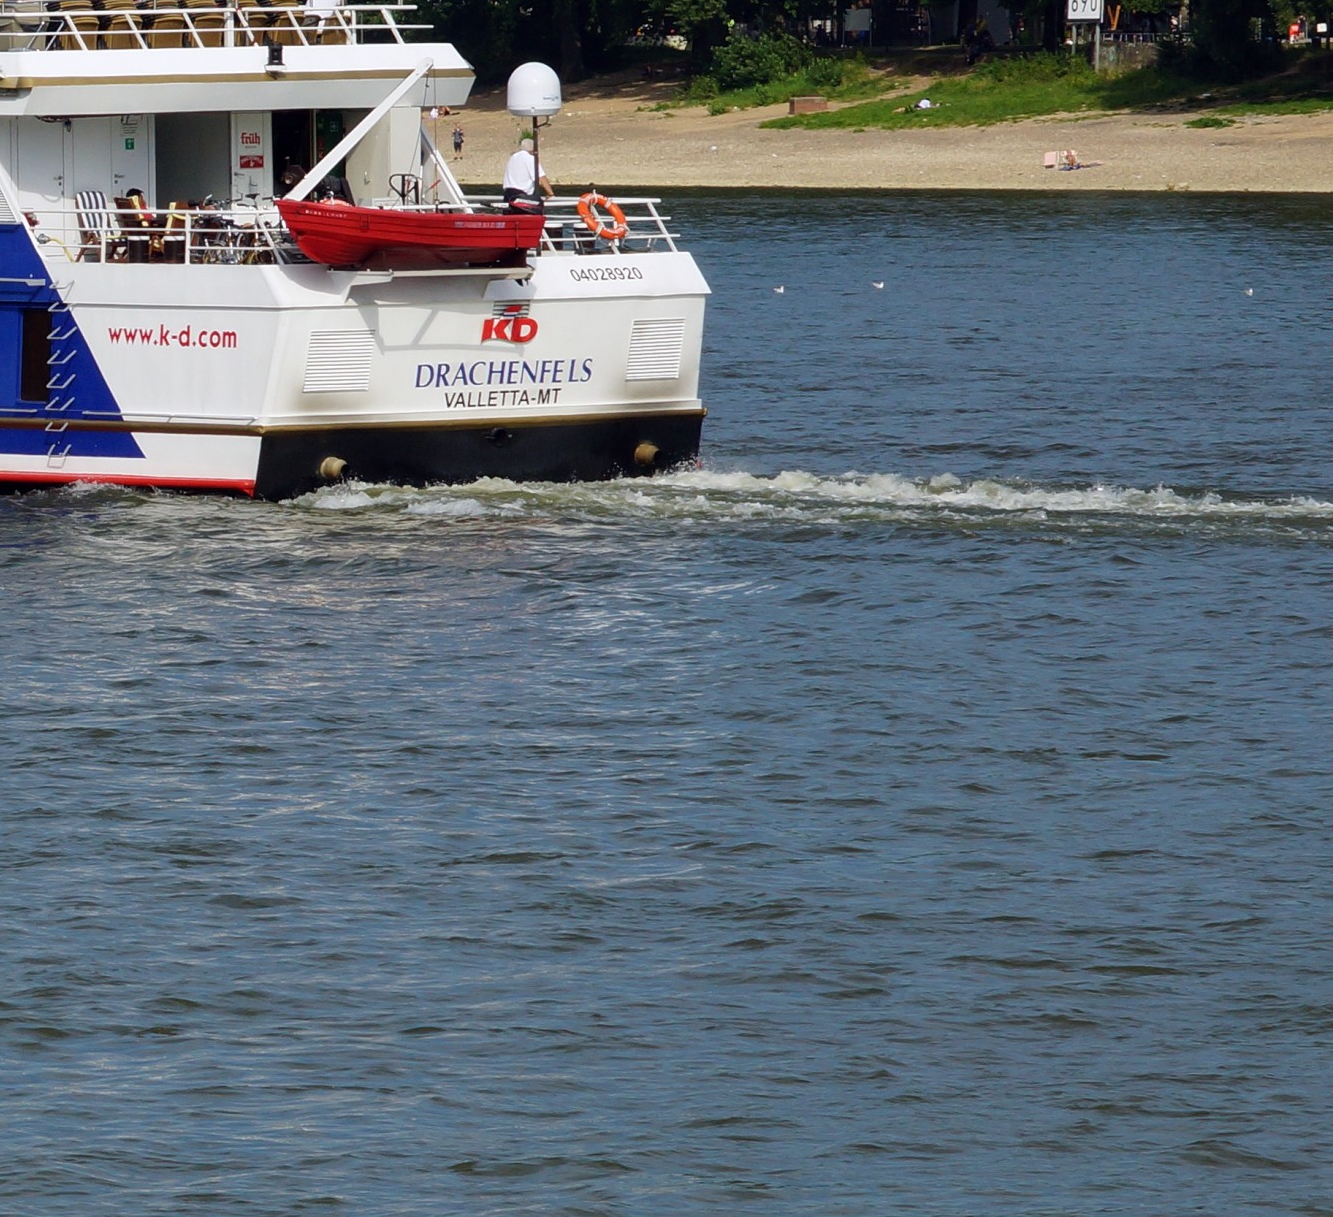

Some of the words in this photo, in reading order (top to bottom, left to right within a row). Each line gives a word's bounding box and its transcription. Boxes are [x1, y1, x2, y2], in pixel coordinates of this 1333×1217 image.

[240, 132, 261, 146] früh
[570, 266, 643, 282] 04028920
[108, 323, 237, 349] www.k-d.com
[480, 316, 539, 344] KD
[415, 358, 593, 388] DRACHENFELS
[444, 387, 562, 409] VALLETTA-MT
